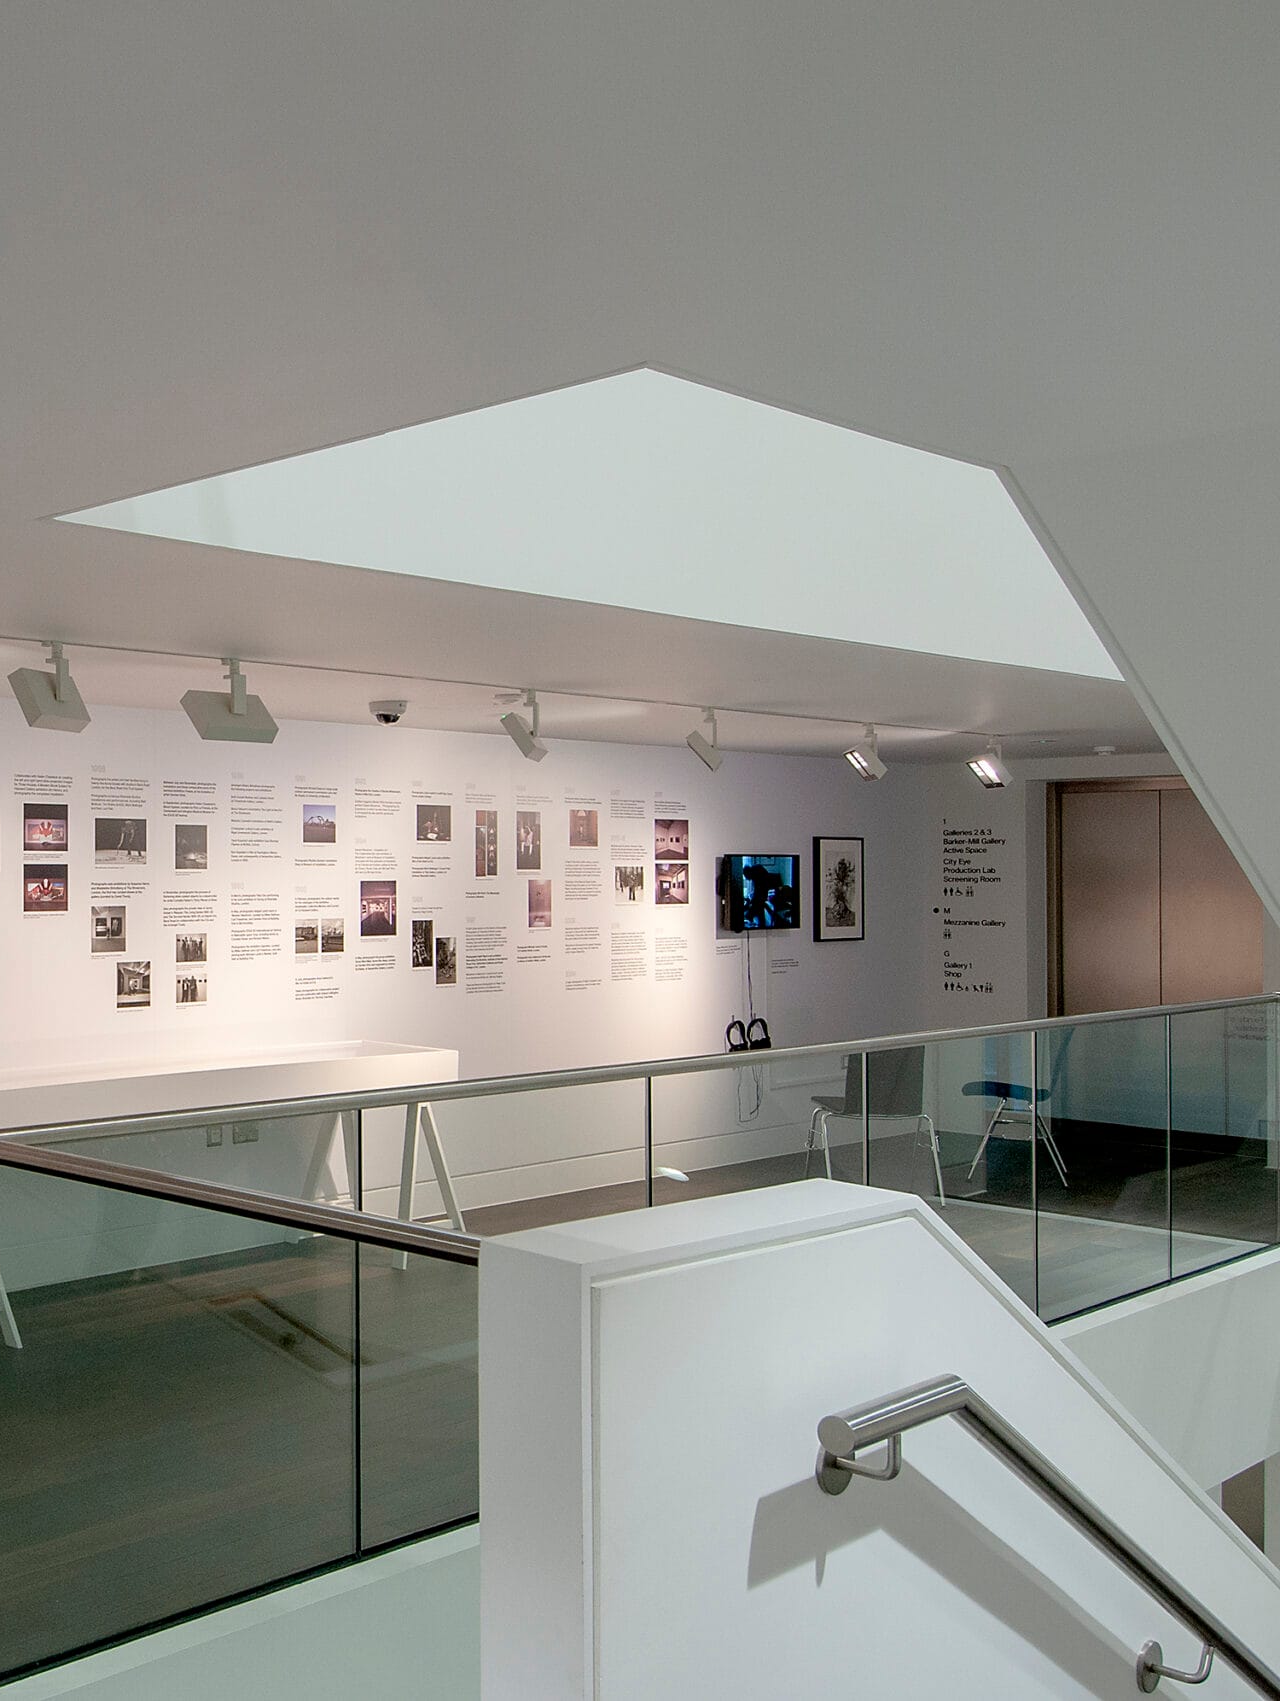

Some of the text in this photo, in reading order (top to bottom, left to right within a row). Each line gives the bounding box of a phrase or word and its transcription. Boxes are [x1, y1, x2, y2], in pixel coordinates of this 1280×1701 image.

[981, 838, 1006, 846] Gallery
[981, 920, 1006, 928] Gallery
[944, 962, 968, 970] Gallery
